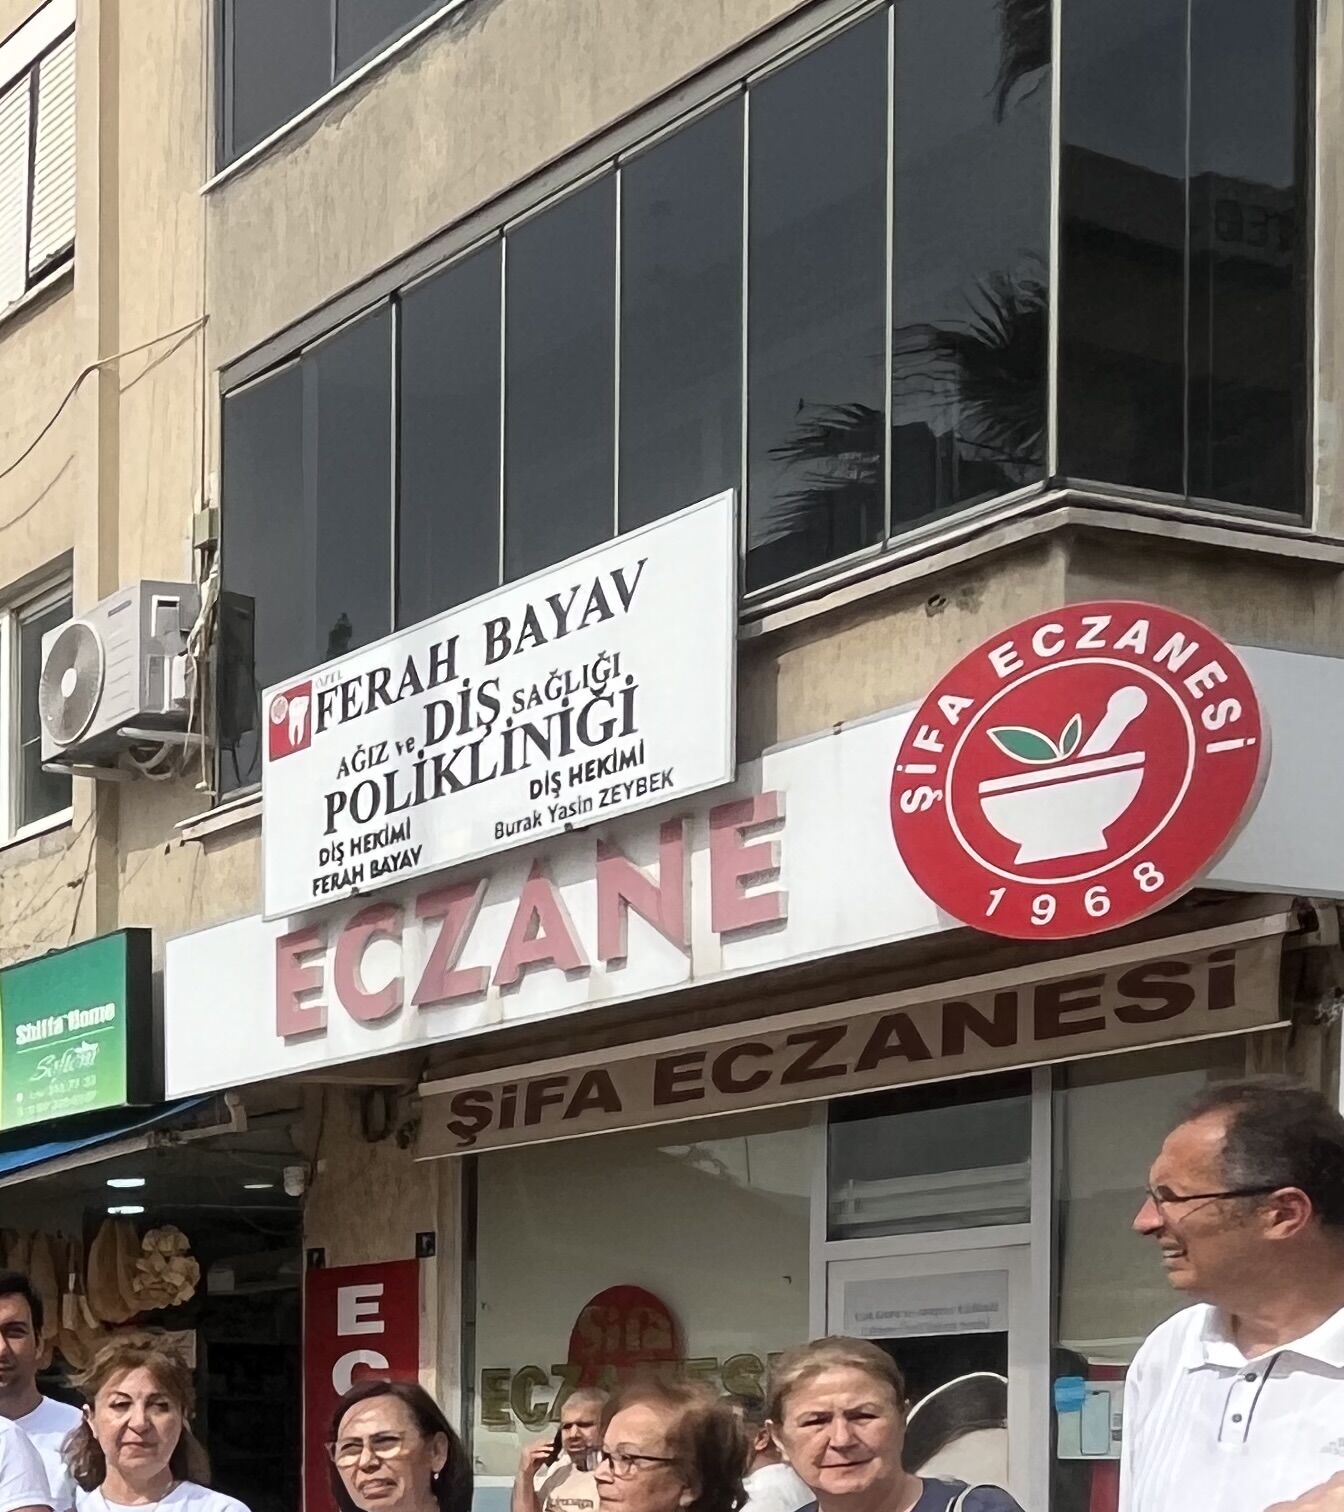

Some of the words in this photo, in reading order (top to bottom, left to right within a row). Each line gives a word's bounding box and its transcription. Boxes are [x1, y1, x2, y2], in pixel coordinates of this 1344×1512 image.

[315, 635, 459, 734] FERAH
[484, 557, 648, 665] BAYAV
[336, 740, 390, 780] AĞIZ
[395, 736, 415, 756] ve
[423, 677, 501, 748] DİŞ
[512, 650, 622, 715] SAĞLIĞI
[896, 694, 975, 814] ŞİFA
[987, 615, 1257, 754] ECZANESİ
[323, 674, 640, 836] POLİKLİNİĞİ
[495, 810, 542, 839] Burak
[547, 796, 593, 823] Yasin
[598, 767, 674, 809] ZEYBEK
[568, 737, 645, 788] HEKİMİ
[276, 791, 789, 1042] ECZANE
[312, 863, 364, 897] FERAH
[370, 844, 423, 879] BAYAV
[984, 860, 1165, 926] 1968
[446, 1070, 623, 1146] ŞİFA
[652, 950, 1238, 1106] ECZANESİ
